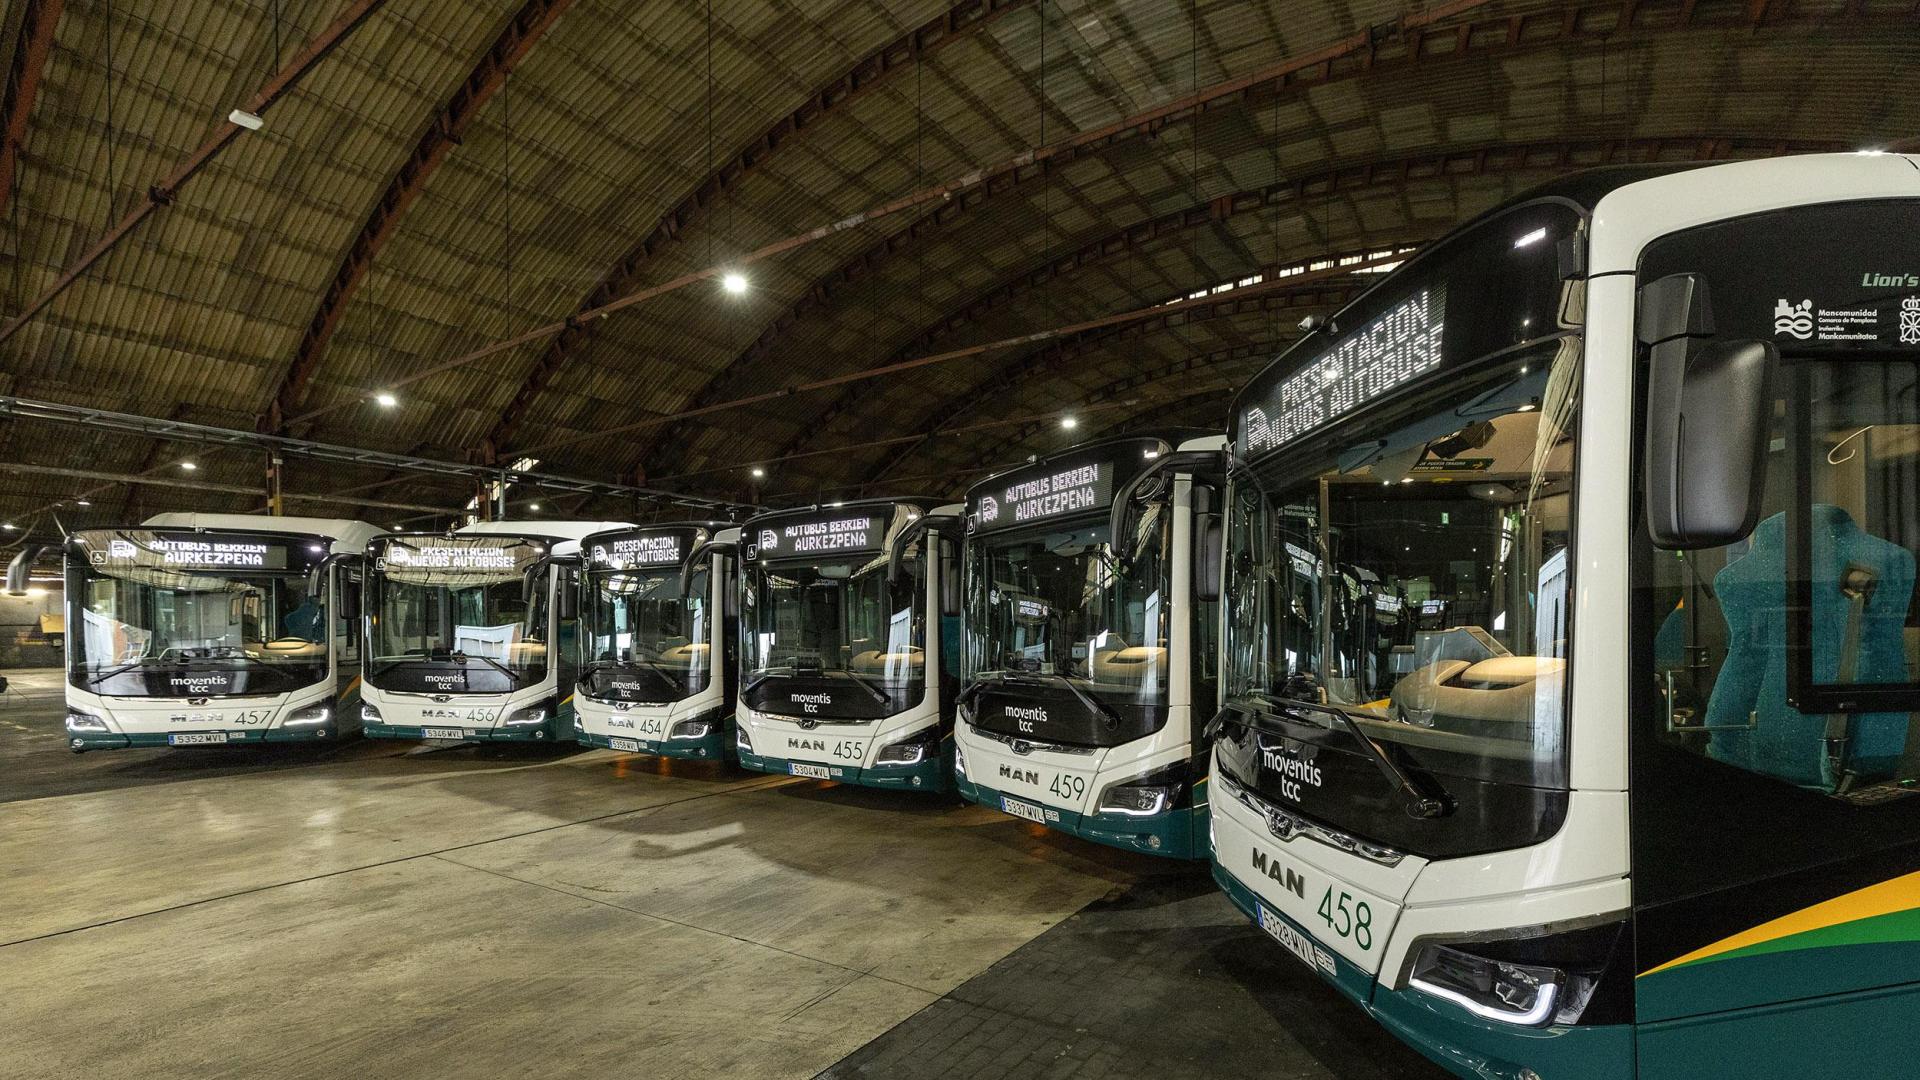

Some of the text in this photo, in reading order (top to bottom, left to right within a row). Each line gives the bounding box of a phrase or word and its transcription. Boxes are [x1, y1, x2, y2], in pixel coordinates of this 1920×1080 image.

[1862, 273, 1920, 286] Lion's
[1282, 291, 1428, 412] PRESENTACION
[1266, 323, 1444, 450] NUEVOS AUTOBUSE
[1006, 464, 1098, 504] AUTOBUS BERRIEN
[1015, 486, 1094, 520] AURKEZPENA
[786, 518, 870, 537] AUTOBUS BERRIEN
[150, 540, 266, 553] AUTOBUS BERRIEN
[614, 536, 674, 552] PRESENTACION
[795, 531, 866, 551] AURKEZPENA
[164, 552, 263, 565] AURKEZPENA
[420, 547, 504, 556] PRESENTACION
[637, 548, 679, 562] AUTOBUSE
[408, 556, 449, 567] NUEVOS
[170, 676, 227, 685] moventis
[612, 681, 640, 690] moventis
[791, 693, 831, 704] moventis
[467, 709, 494, 721] 456
[804, 703, 818, 713] tcc
[1005, 706, 1048, 722] moventis
[234, 711, 271, 724] 457
[640, 720, 661, 734] 454
[1019, 719, 1033, 733] tcc
[788, 738, 862, 759] MAN 455
[1263, 750, 1322, 788] moventis
[1000, 764, 1084, 801] MAN 459
[1281, 778, 1300, 802] tcc
[1252, 847, 1372, 951] MAN 458
